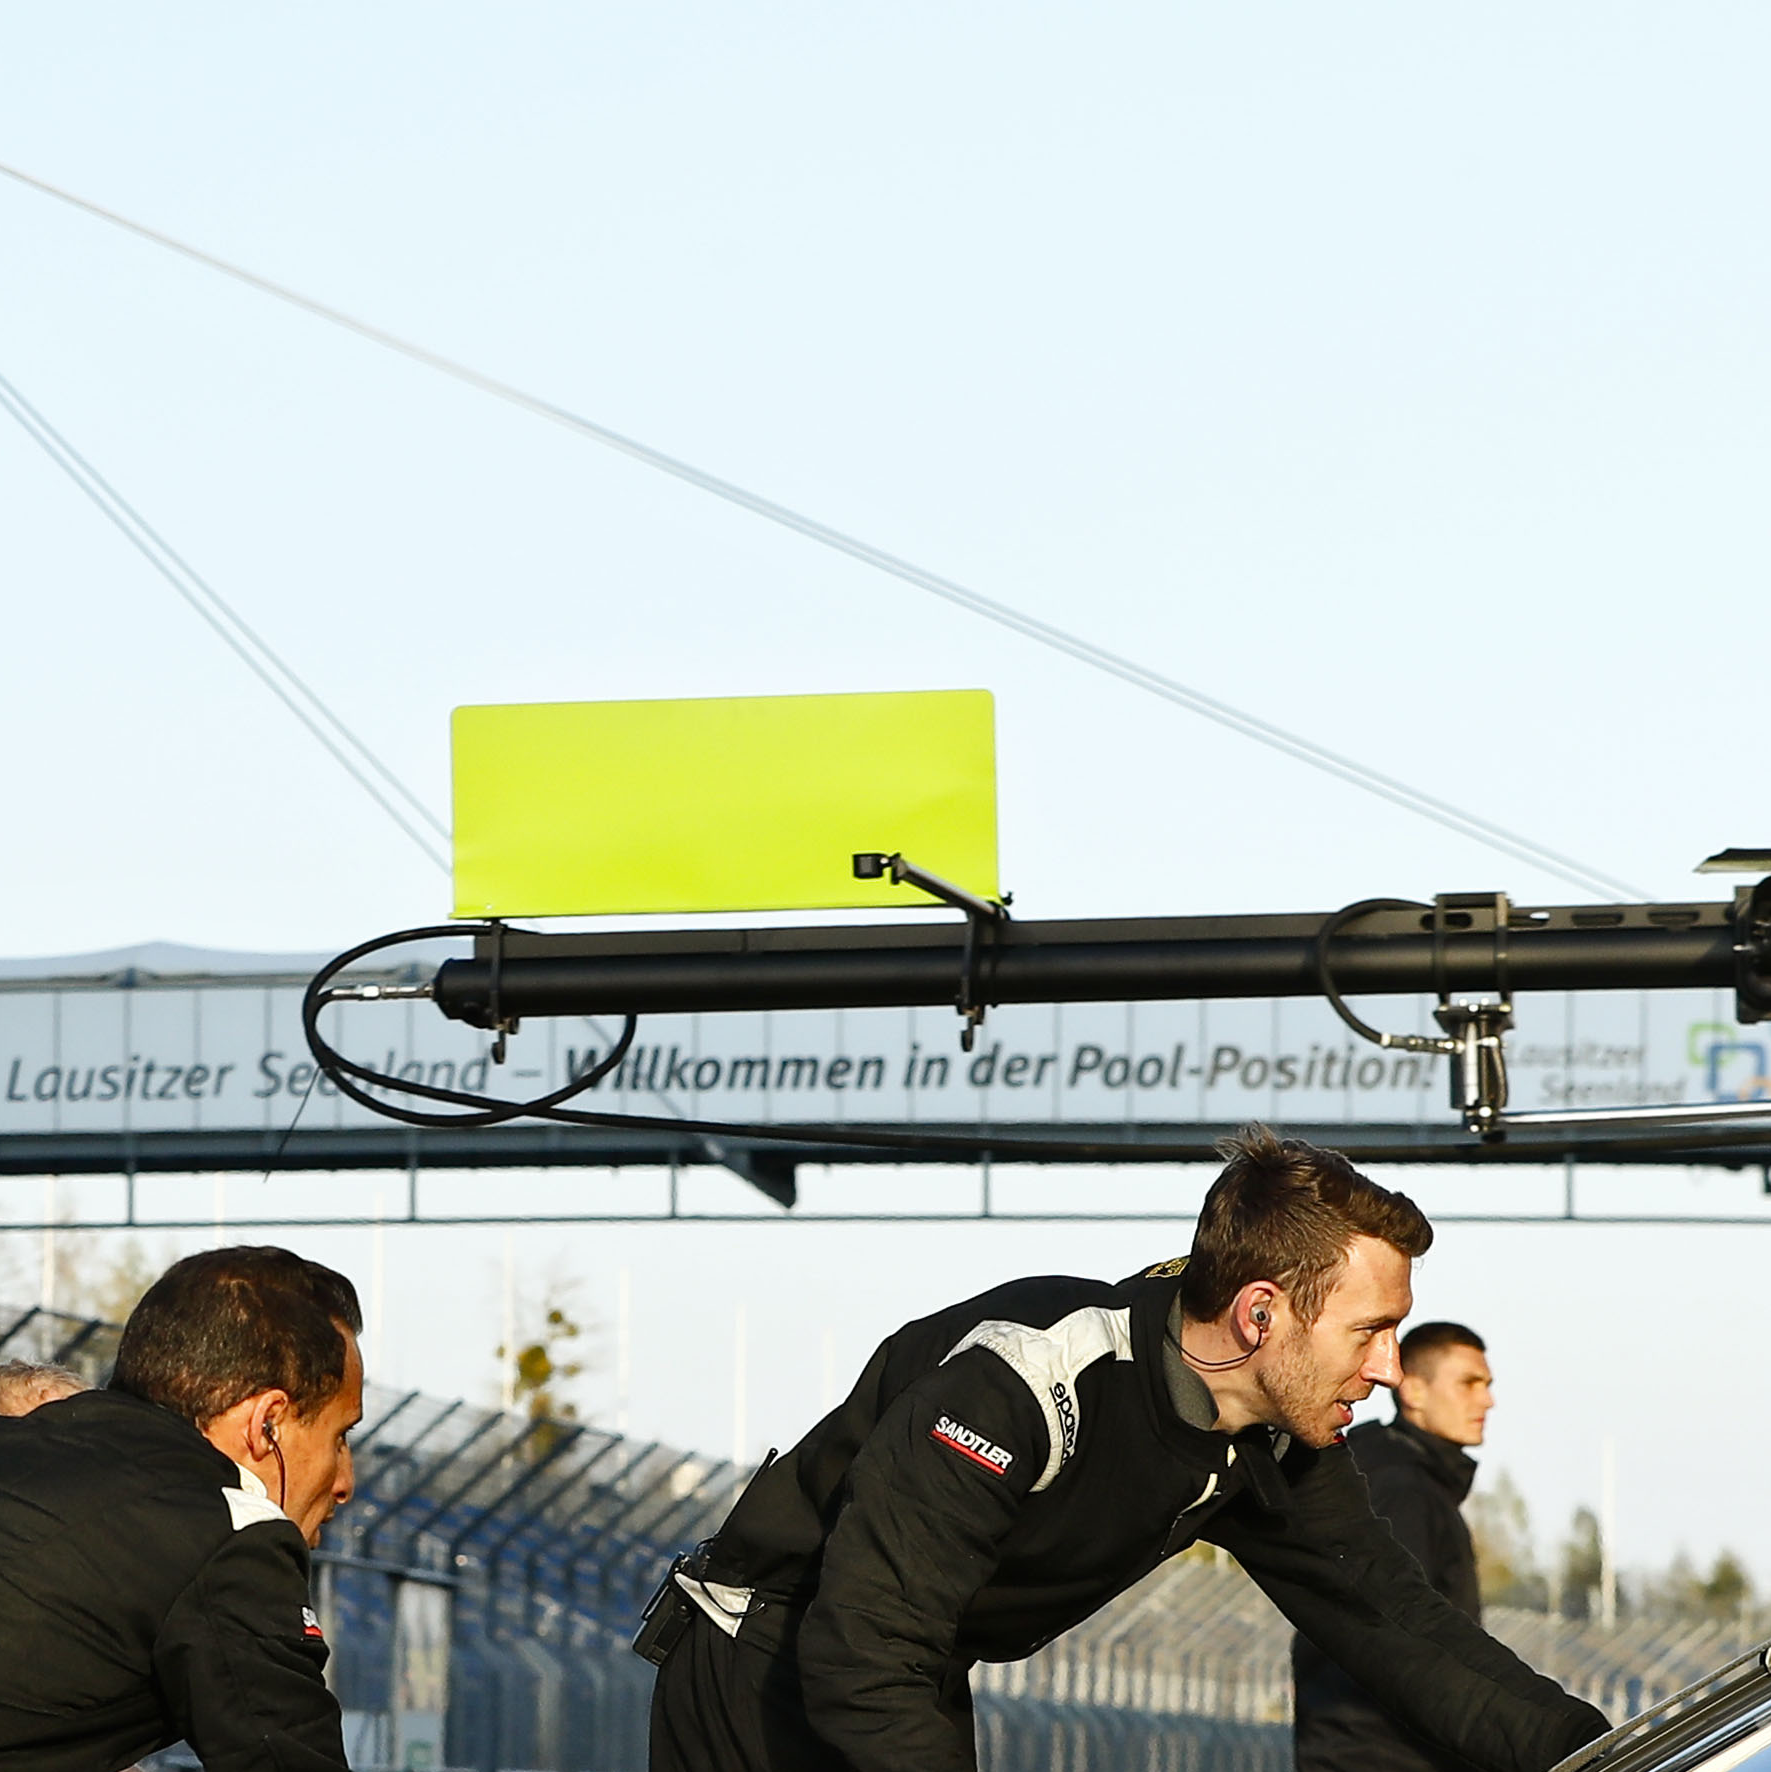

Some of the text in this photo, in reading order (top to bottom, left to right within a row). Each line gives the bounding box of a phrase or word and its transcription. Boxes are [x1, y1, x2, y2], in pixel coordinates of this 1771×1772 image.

[6, 1047, 235, 1102] Lausitzer
[567, 1045, 882, 1090] Willkommen
[903, 1044, 950, 1089] in
[968, 1043, 1058, 1089] der
[1068, 1043, 1439, 1090] Pool-Position!
[934, 1415, 1014, 1470] SANDTLER
